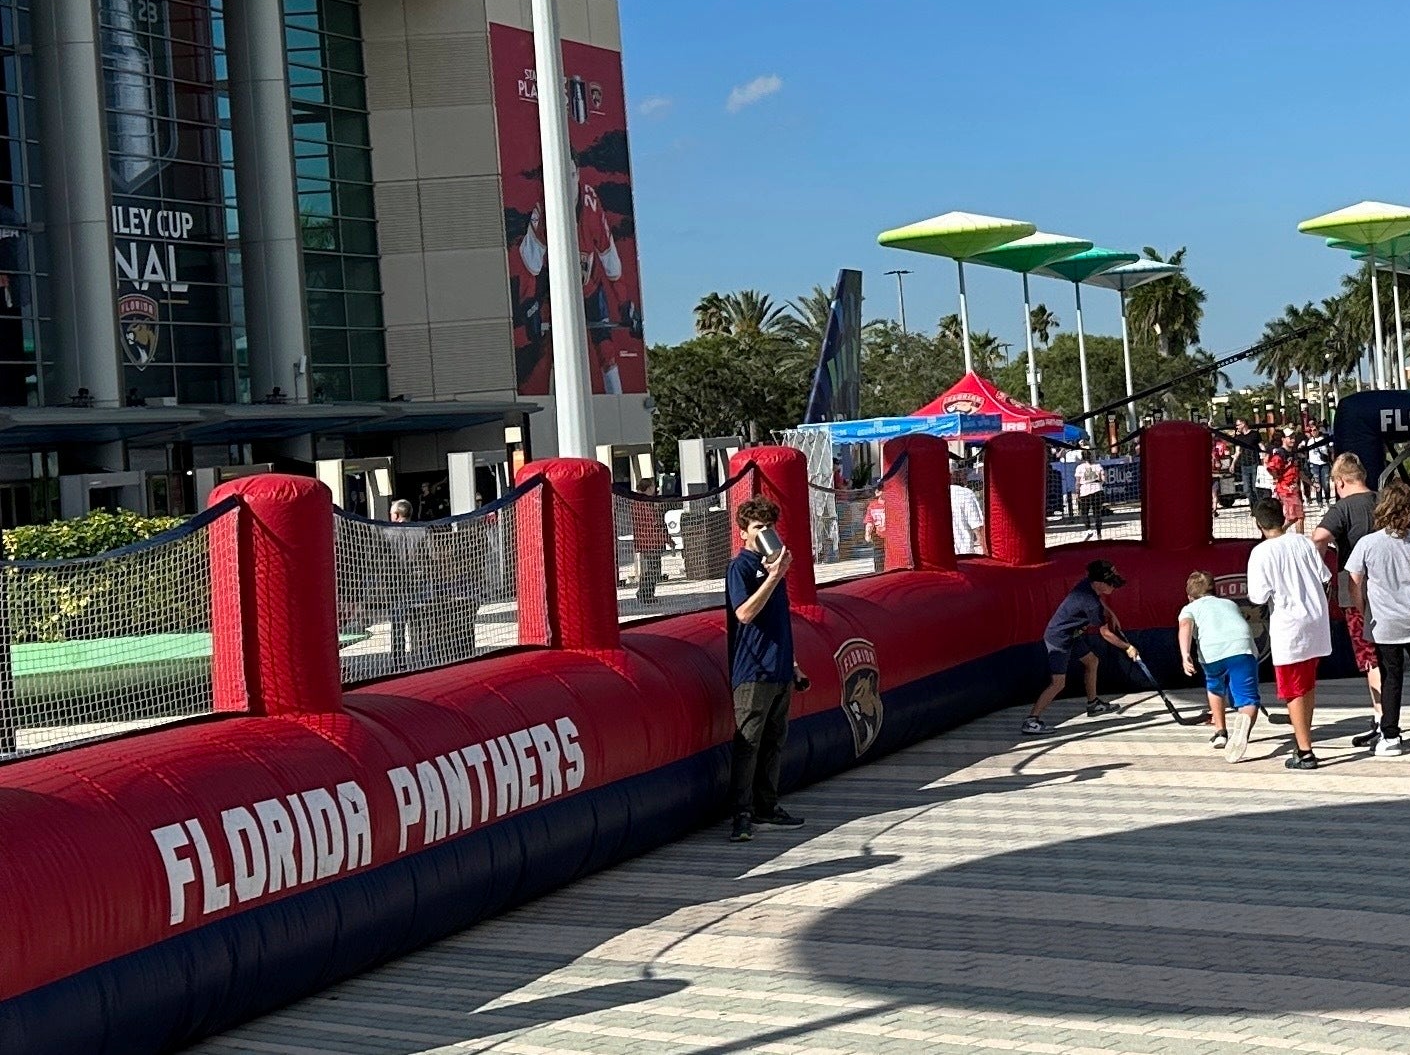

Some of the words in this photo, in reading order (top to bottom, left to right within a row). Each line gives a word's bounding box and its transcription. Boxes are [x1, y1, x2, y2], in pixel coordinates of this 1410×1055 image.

[157, 210, 193, 239] CUP
[120, 300, 154, 316] FLORIDA
[843, 649, 876, 673] FLORIDA
[151, 780, 372, 926] FLORIDA
[387, 716, 585, 854] PANTHERS
